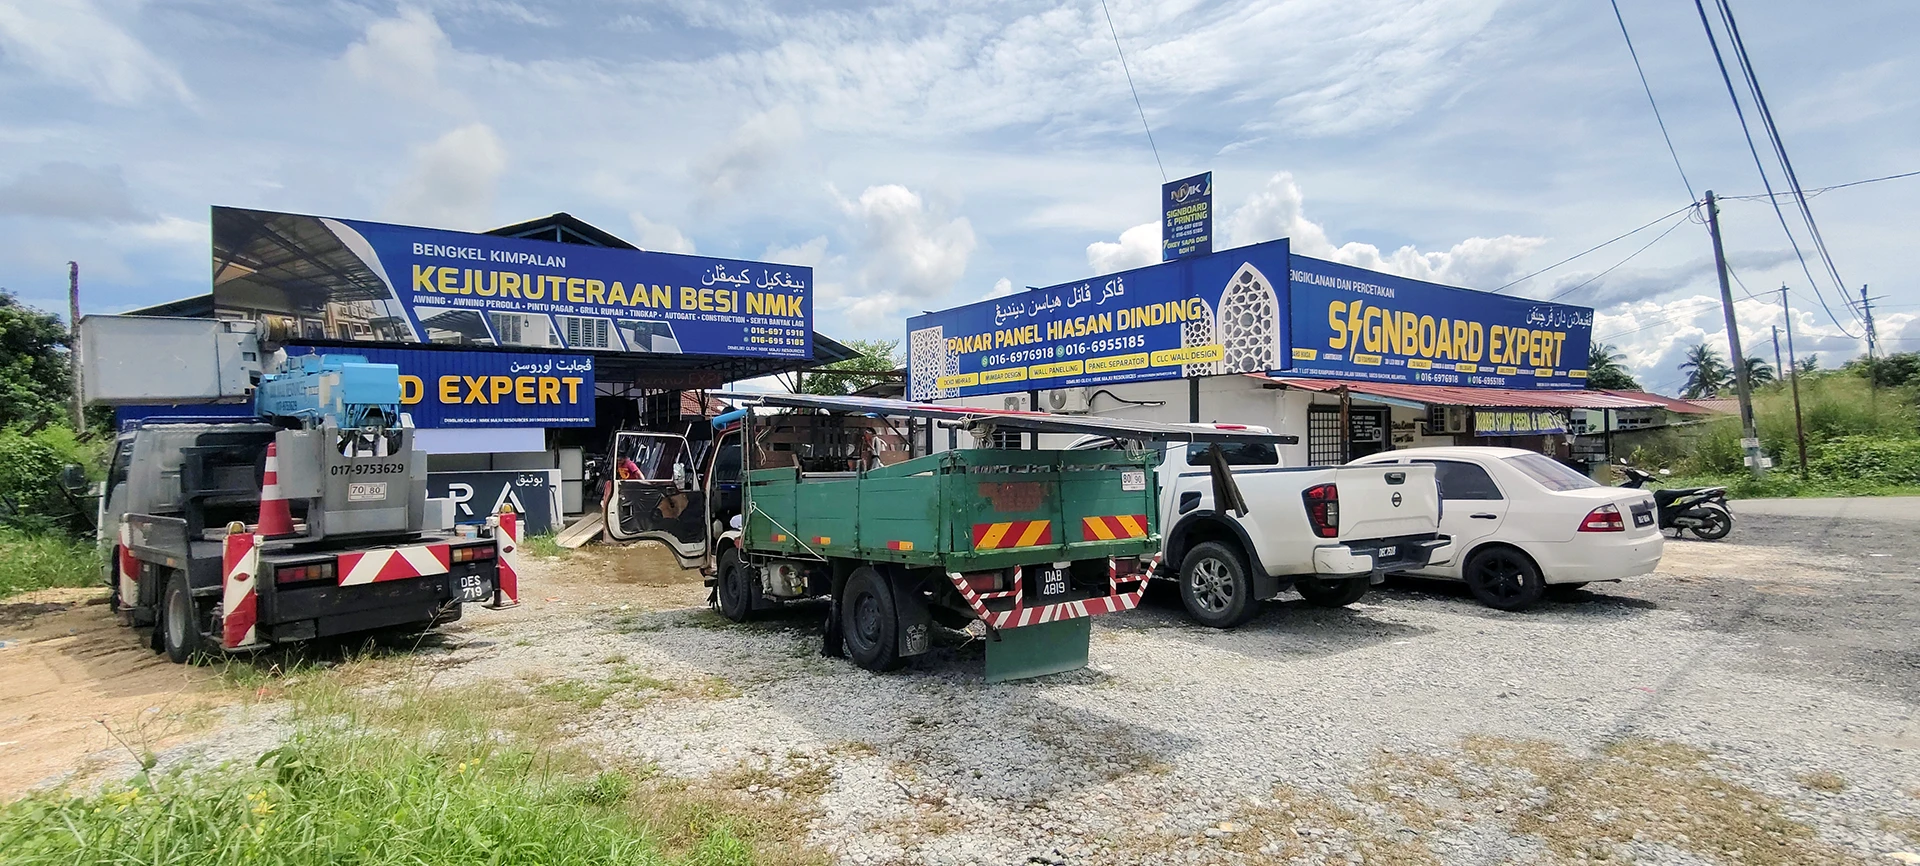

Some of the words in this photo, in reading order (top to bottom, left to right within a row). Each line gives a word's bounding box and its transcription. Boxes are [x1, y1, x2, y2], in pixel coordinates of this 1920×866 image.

[1166, 202, 1207, 219] SIGNBOARD
[1167, 219, 1172, 227] &
[1174, 210, 1207, 226] PRINTING
[413, 242, 486, 261] BENGKEL
[490, 250, 566, 268] KIMPALAN
[412, 264, 671, 309] KEJURUTERAAN
[680, 286, 738, 313] BESI
[746, 292, 804, 318] NMK
[1336, 278, 1352, 291] DAN
[1353, 281, 1395, 298] PERCETAKAN
[413, 294, 446, 305] AWNING
[453, 298, 484, 308] AWNING
[486, 300, 520, 310] PERGOLA
[527, 302, 549, 312] PINTU
[550, 304, 574, 313] PAGAR
[580, 306, 600, 315] GRILL
[600, 307, 624, 316] RUMAH
[630, 309, 658, 318] TINGKAP
[664, 311, 696, 320] AUTOGATE
[701, 314, 746, 324] CONSTRUCTION
[750, 316, 768, 325] SERTA
[769, 318, 790, 326] BANYAK
[792, 319, 804, 328] LAGI
[947, 332, 992, 356] PAKAR
[995, 324, 1043, 349] PANEL
[1047, 312, 1112, 341] HIASAN
[1117, 298, 1201, 331] DINDING
[1328, 300, 1484, 362] SIGNBOARD
[1489, 325, 1566, 367] EXPERT
[1065, 334, 1145, 356] 016-6955185
[989, 347, 1054, 366] 016-6976918
[1156, 354, 1169, 363] CLC
[1171, 352, 1189, 361] WALL
[1191, 350, 1218, 359] DESIGN
[1034, 367, 1048, 376] WALL
[1049, 364, 1079, 374] PANELLING
[1088, 361, 1107, 370] PANEL
[1108, 358, 1145, 368] SEPARATOR
[1004, 371, 1022, 379] DESIGN
[1421, 372, 1458, 383] 016-6976918
[1472, 376, 1505, 386] 016-6955185
[438, 374, 584, 405] EXPERT
[331, 463, 404, 476] 017-9753629
[1123, 474, 1131, 484] 80
[461, 575, 481, 588] DES
[1045, 570, 1062, 583] DAB
[463, 586, 482, 599] 719
[1043, 582, 1065, 595] 4819
